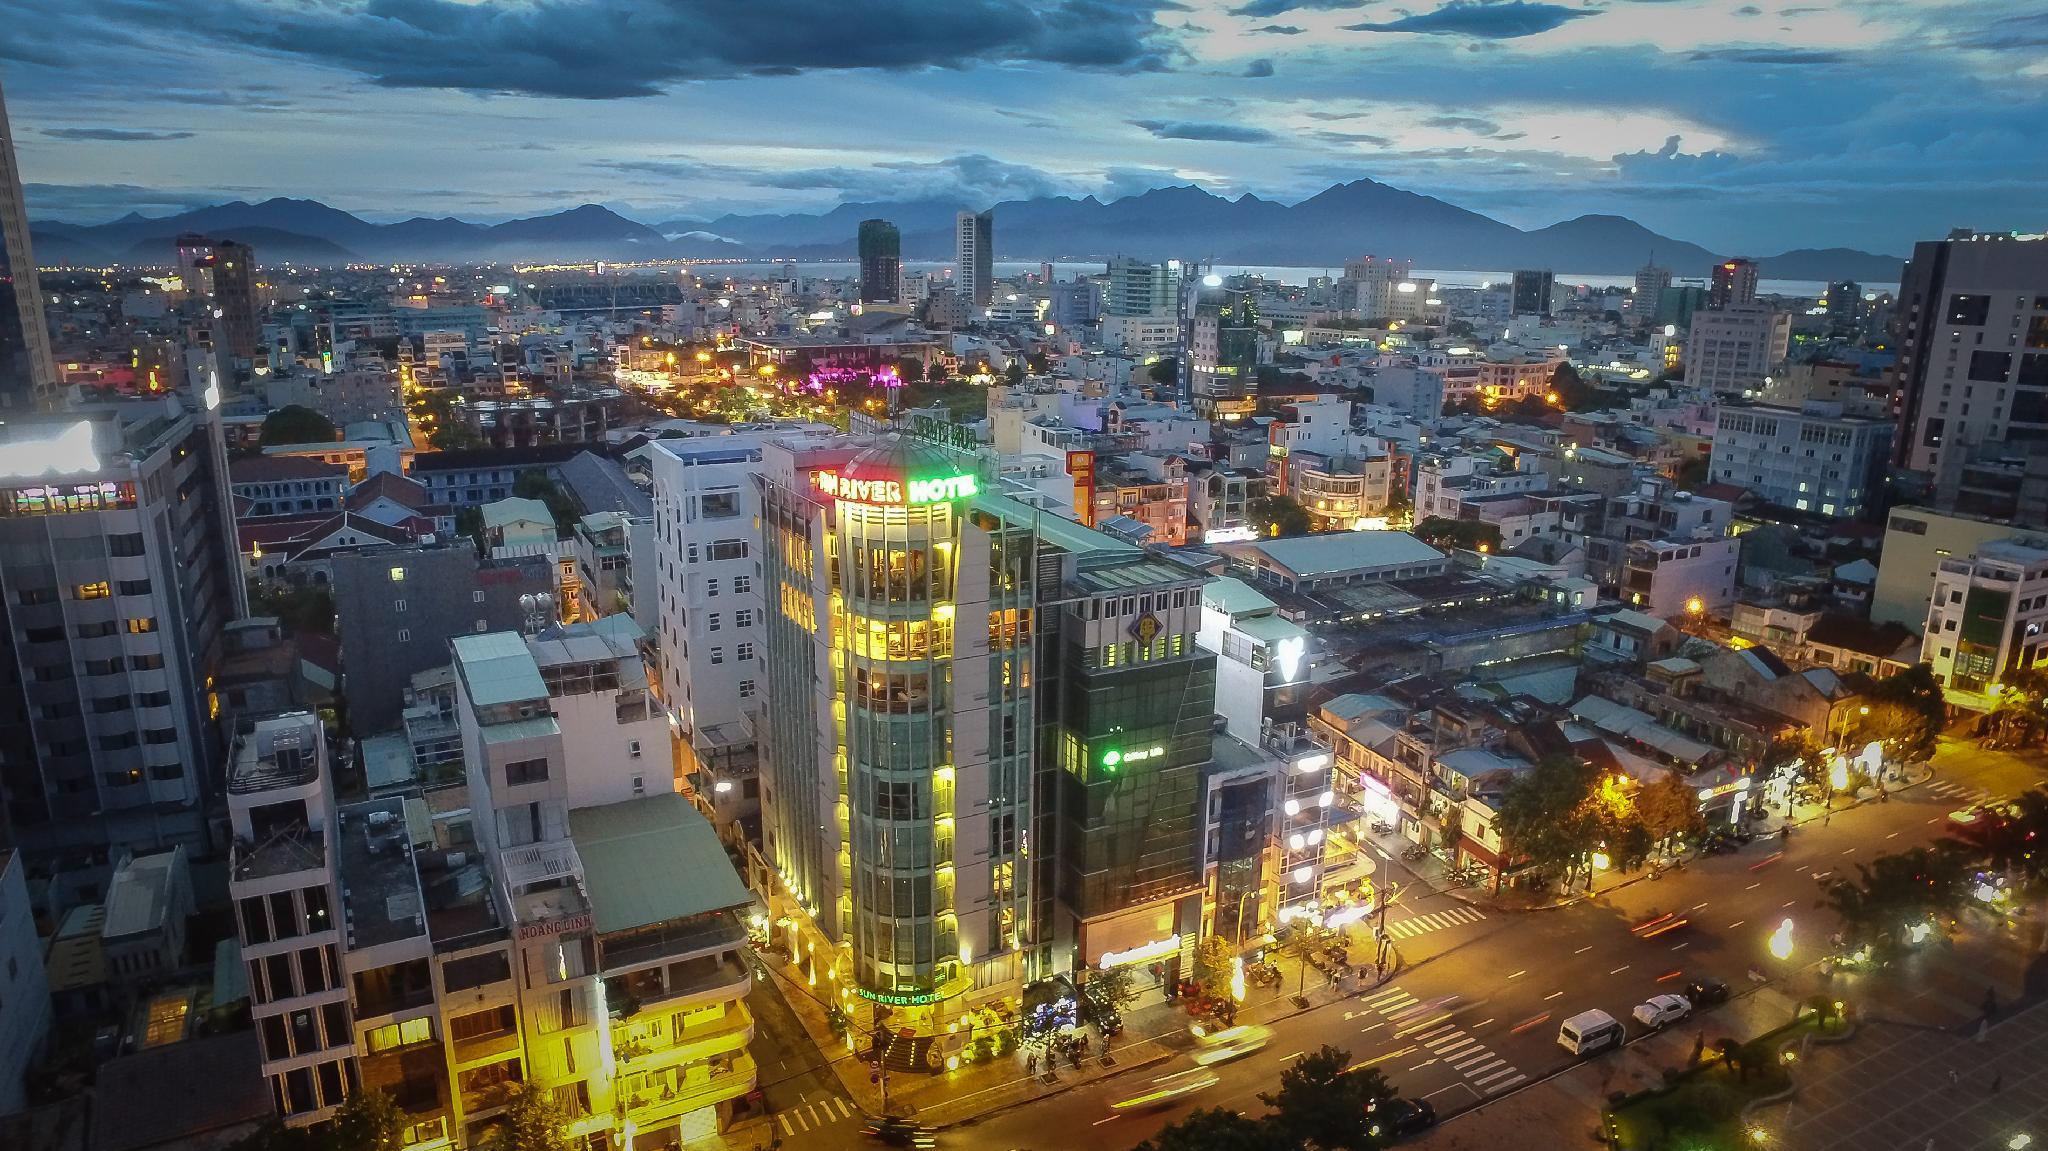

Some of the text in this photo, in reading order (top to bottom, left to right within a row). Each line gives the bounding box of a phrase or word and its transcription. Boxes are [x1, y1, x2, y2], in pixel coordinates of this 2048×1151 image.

[840, 478, 901, 502] RIVER
[908, 474, 978, 504] HOTEL
[859, 988, 945, 1004] SUN RIVER HOTEL
